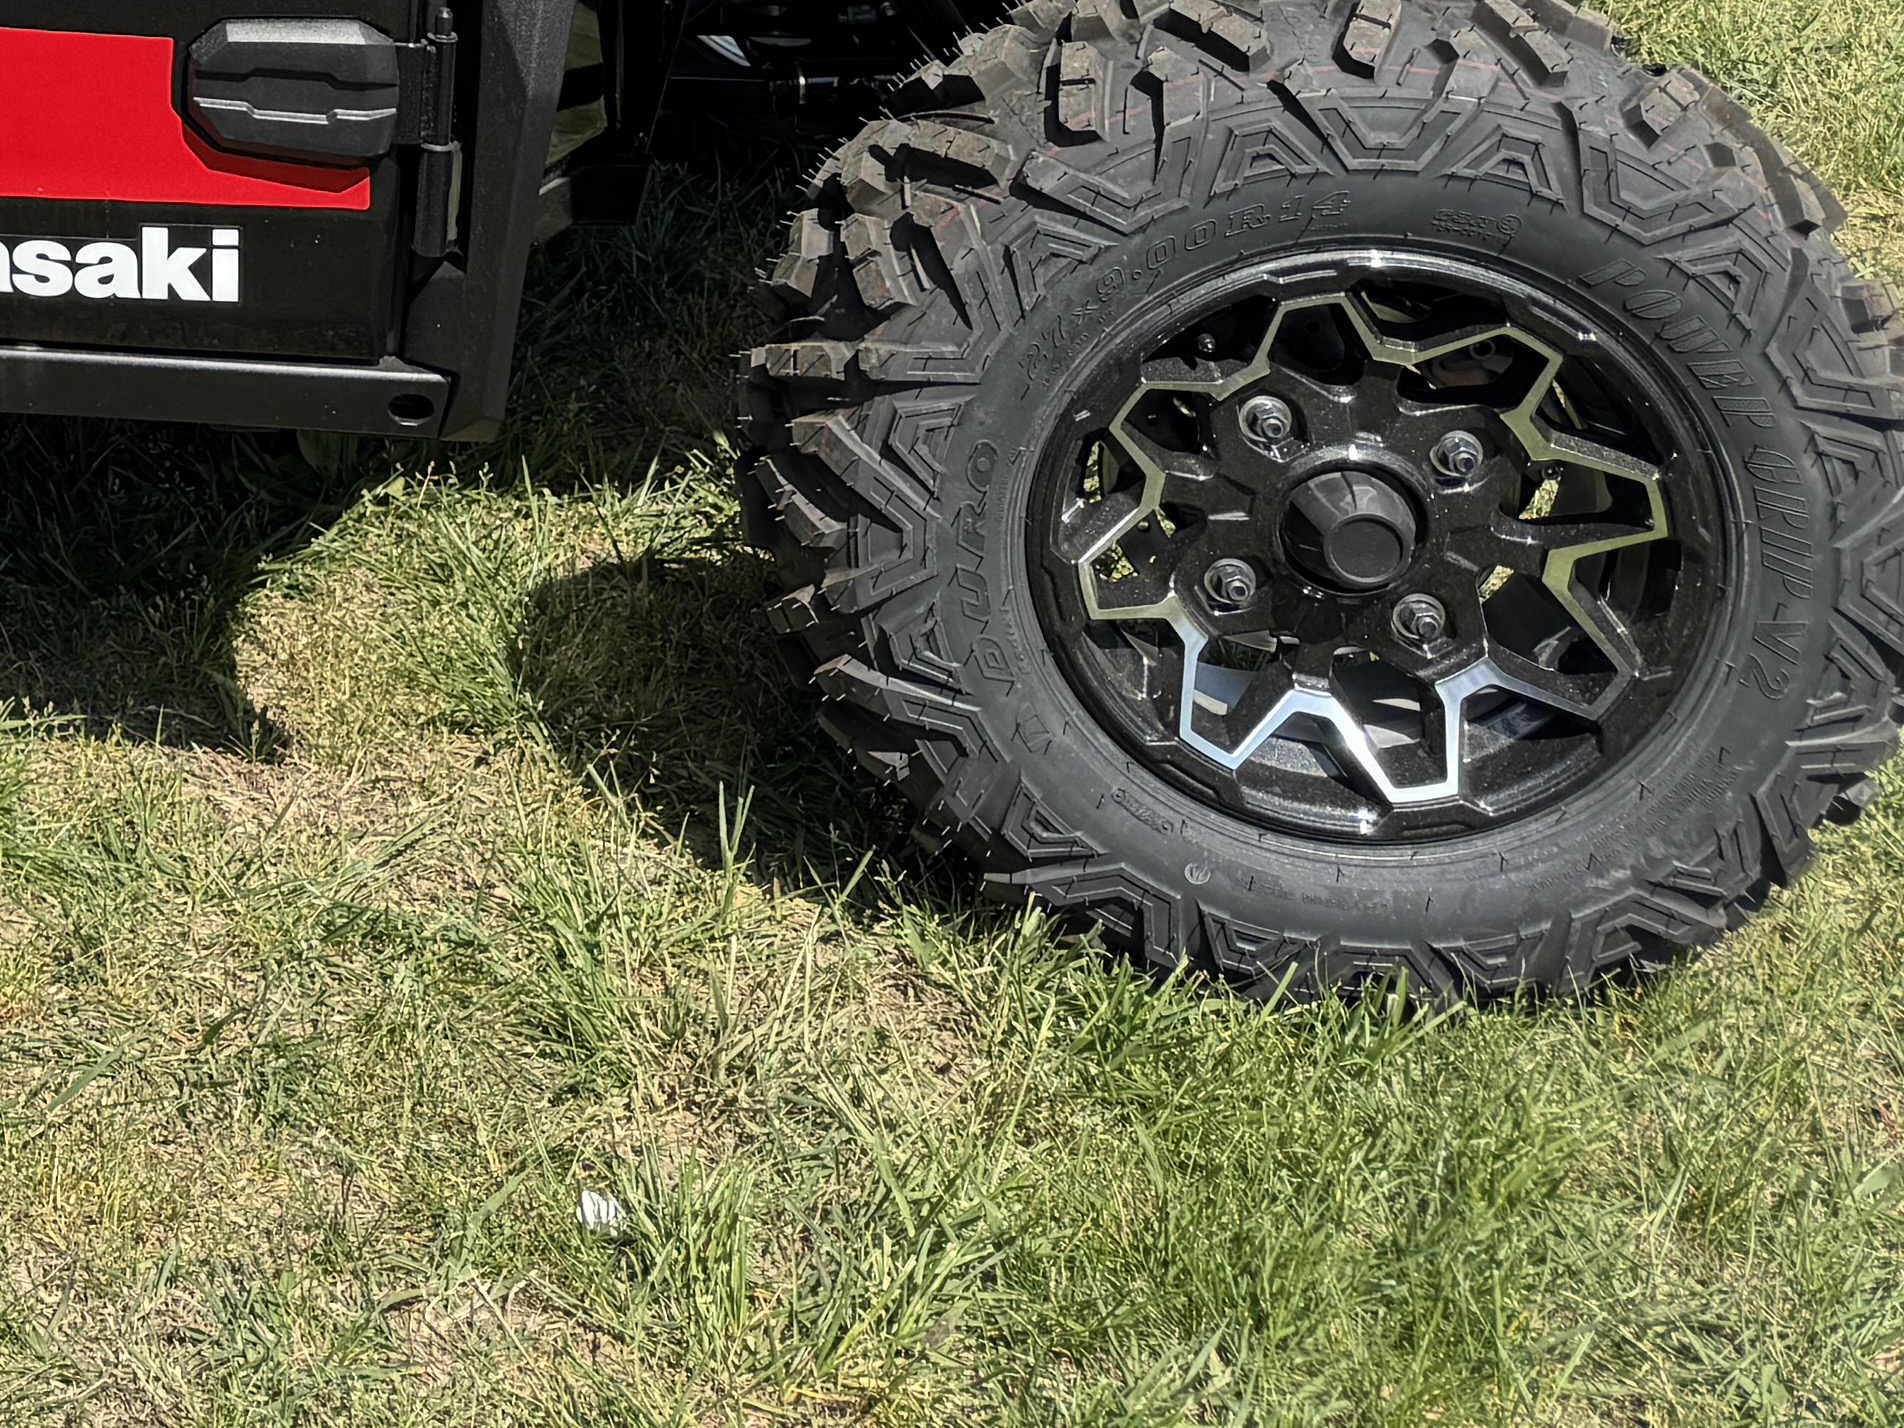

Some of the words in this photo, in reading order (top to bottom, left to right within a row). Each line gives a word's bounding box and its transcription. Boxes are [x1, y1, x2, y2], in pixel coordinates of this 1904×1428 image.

[950, 438, 1016, 698] DURO
[1578, 258, 1778, 430] POWER
[1745, 445, 1814, 599] GRIP
